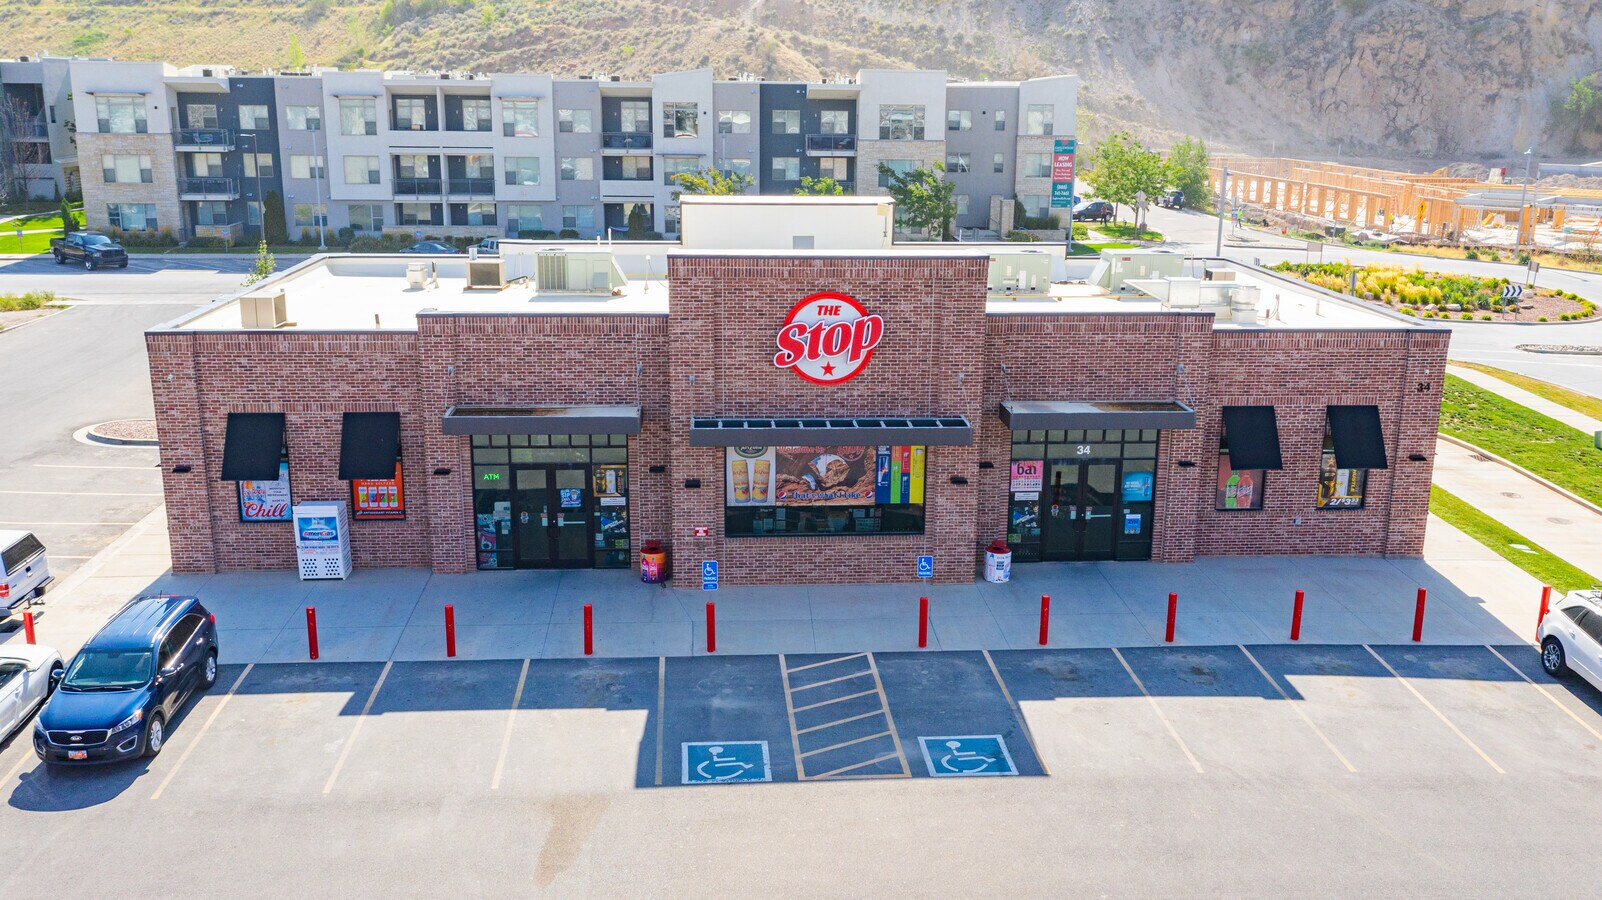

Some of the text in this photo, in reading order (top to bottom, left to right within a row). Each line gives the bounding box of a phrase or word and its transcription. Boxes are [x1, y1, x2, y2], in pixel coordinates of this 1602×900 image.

[817, 305, 842, 316] THE
[774, 315, 884, 368] Stop
[1417, 382, 1431, 391] 34
[1076, 445, 1091, 455] 34
[1017, 463, 1037, 475] bai
[817, 490, 837, 499] what
[245, 503, 288, 517] Chill
